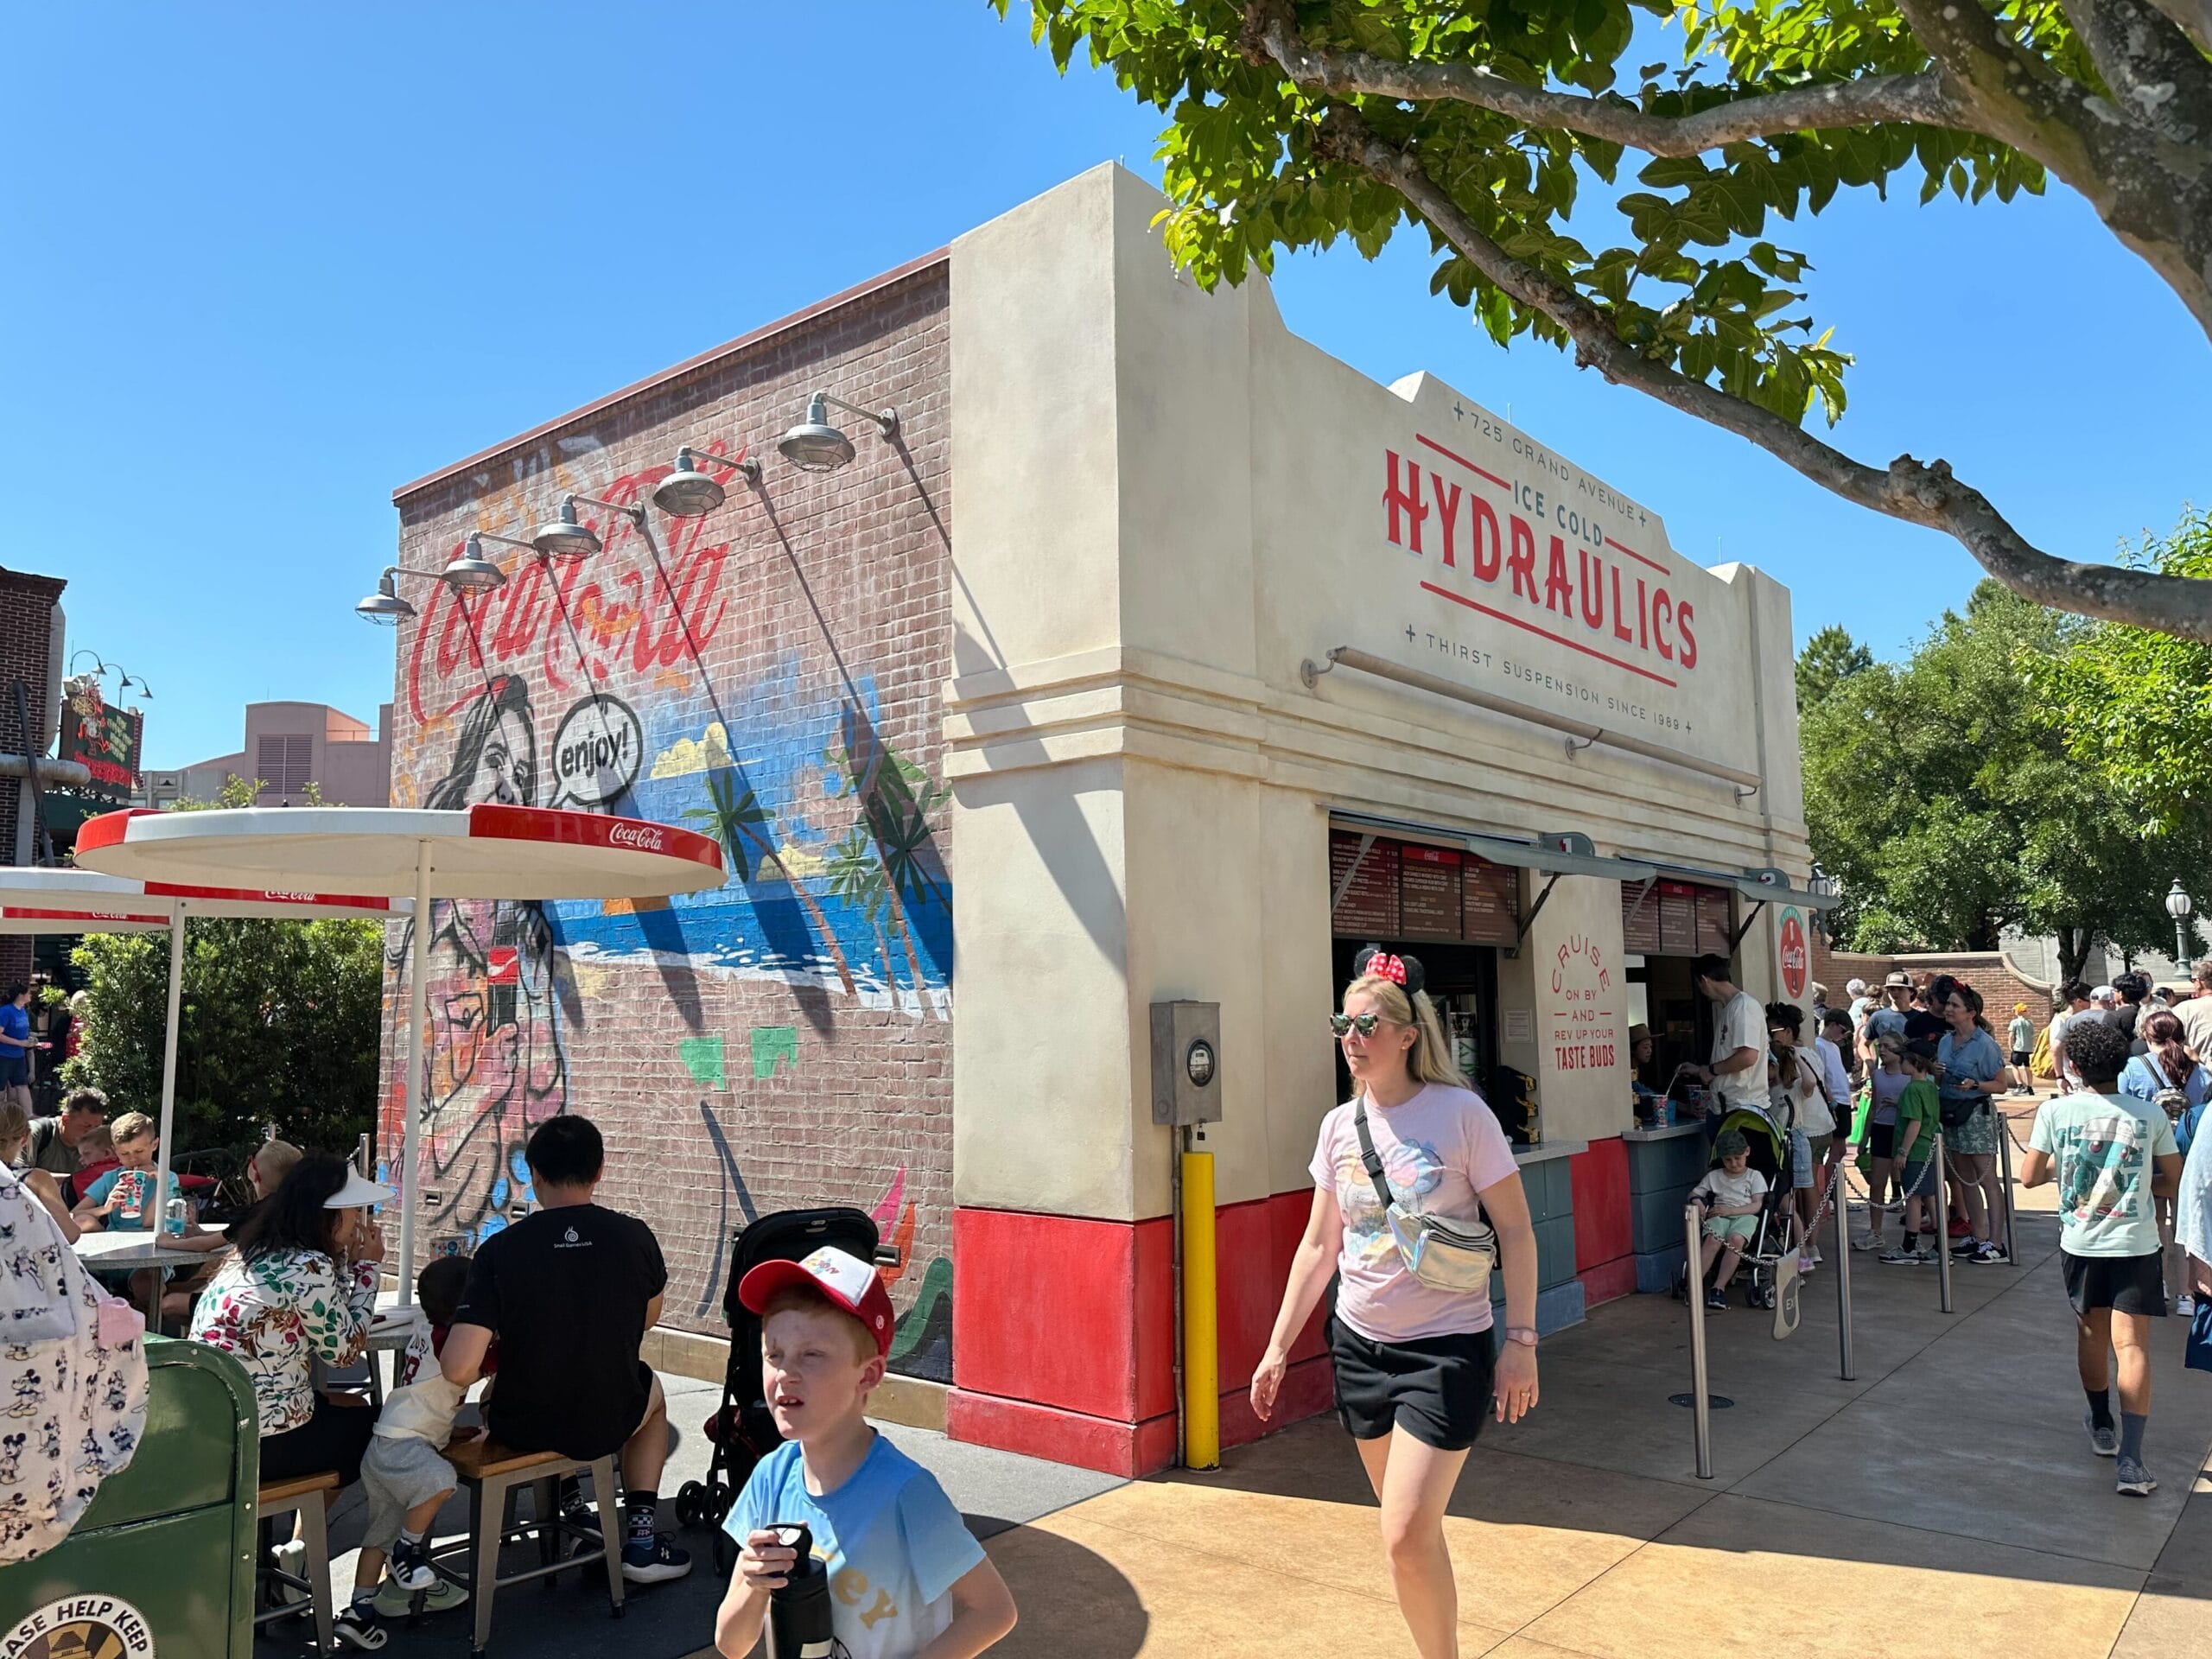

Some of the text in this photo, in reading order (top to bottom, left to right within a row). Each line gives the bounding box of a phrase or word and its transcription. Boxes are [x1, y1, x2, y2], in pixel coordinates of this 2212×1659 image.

[1470, 412, 1635, 520] 725 GRAND AVENUE
[1514, 480, 1603, 547] ICE COLD
[1382, 448, 1698, 671] HYDRAULICS
[1427, 633, 1680, 731] THIRST SUSPENSION SINCE 1989
[562, 721, 628, 777] enjoy!
[609, 823, 664, 851] Coca-Cola
[1560, 838, 1572, 853] 1
[1552, 933, 1610, 994] CRUISE
[1566, 989, 1598, 1001] ON BY
[1572, 1009, 1595, 1022] AND
[1554, 1028, 1614, 1041] REV UP YOUR
[1555, 1044, 1615, 1071] TASTE BUDS
[57, 1600, 113, 1621] HELP
[113, 1609, 148, 1654] KEEP
